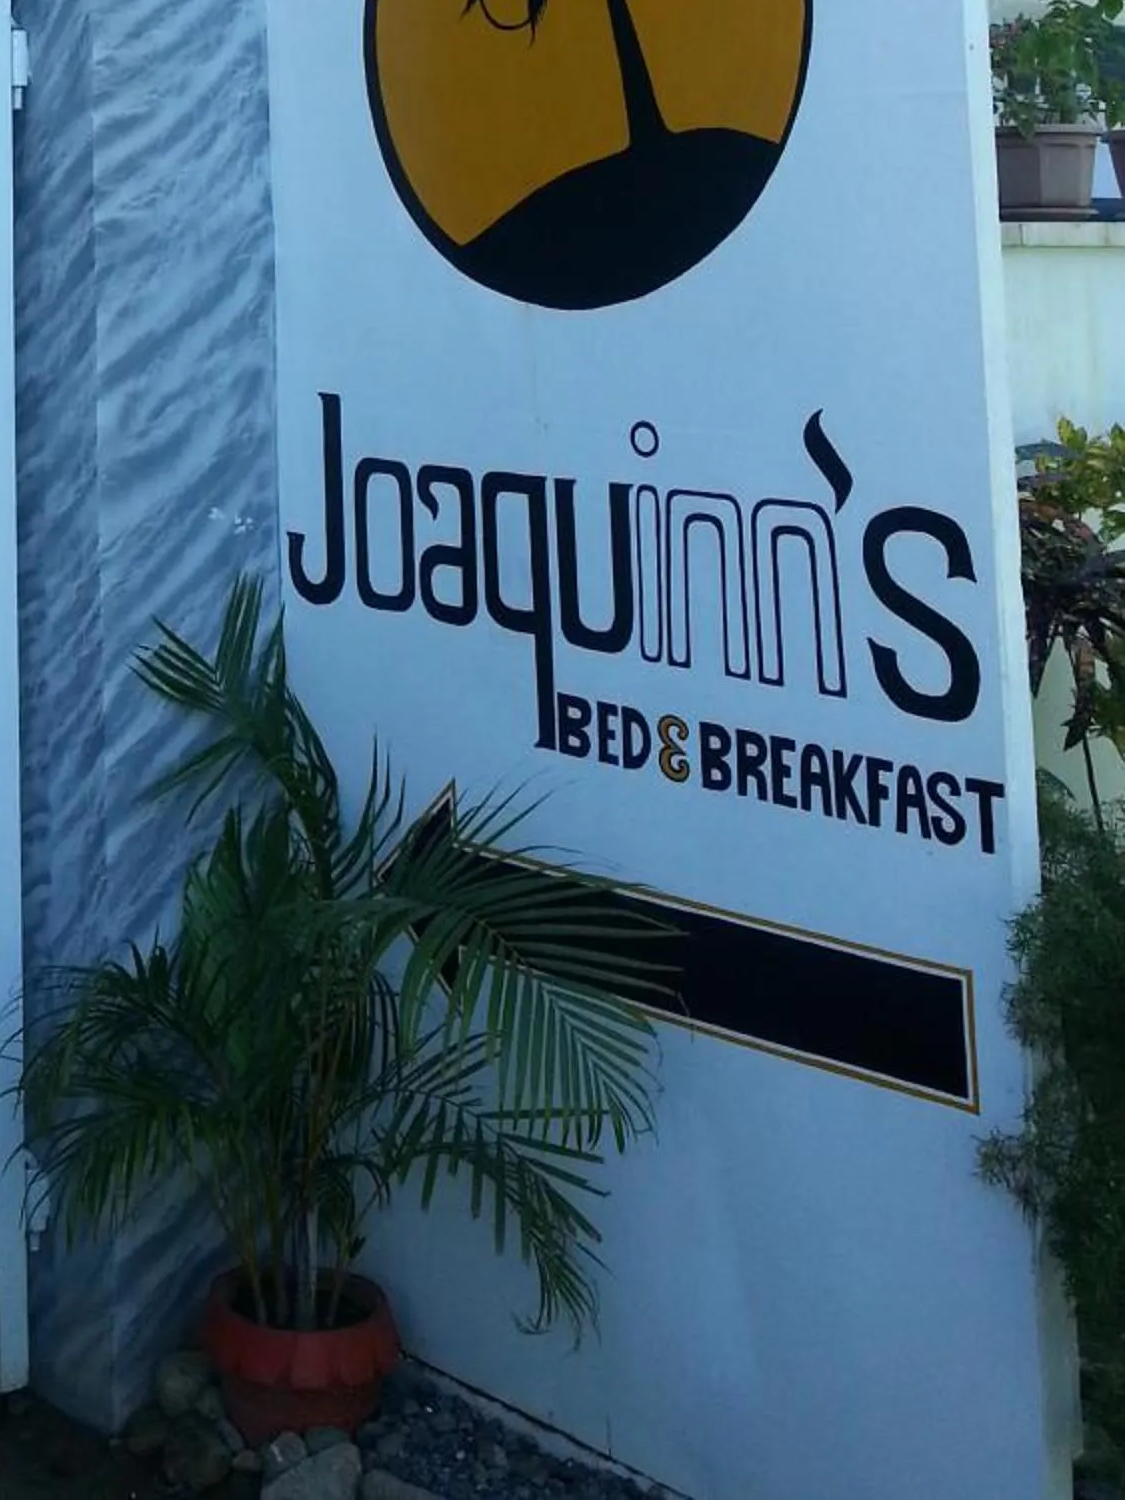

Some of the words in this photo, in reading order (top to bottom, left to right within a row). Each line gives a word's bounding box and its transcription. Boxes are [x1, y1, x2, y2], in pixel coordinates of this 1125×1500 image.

[286, 391, 981, 749] Joaquinn's
[556, 691, 652, 770] BED
[656, 714, 690, 783] &
[698, 720, 1005, 855] BREAKFAST
